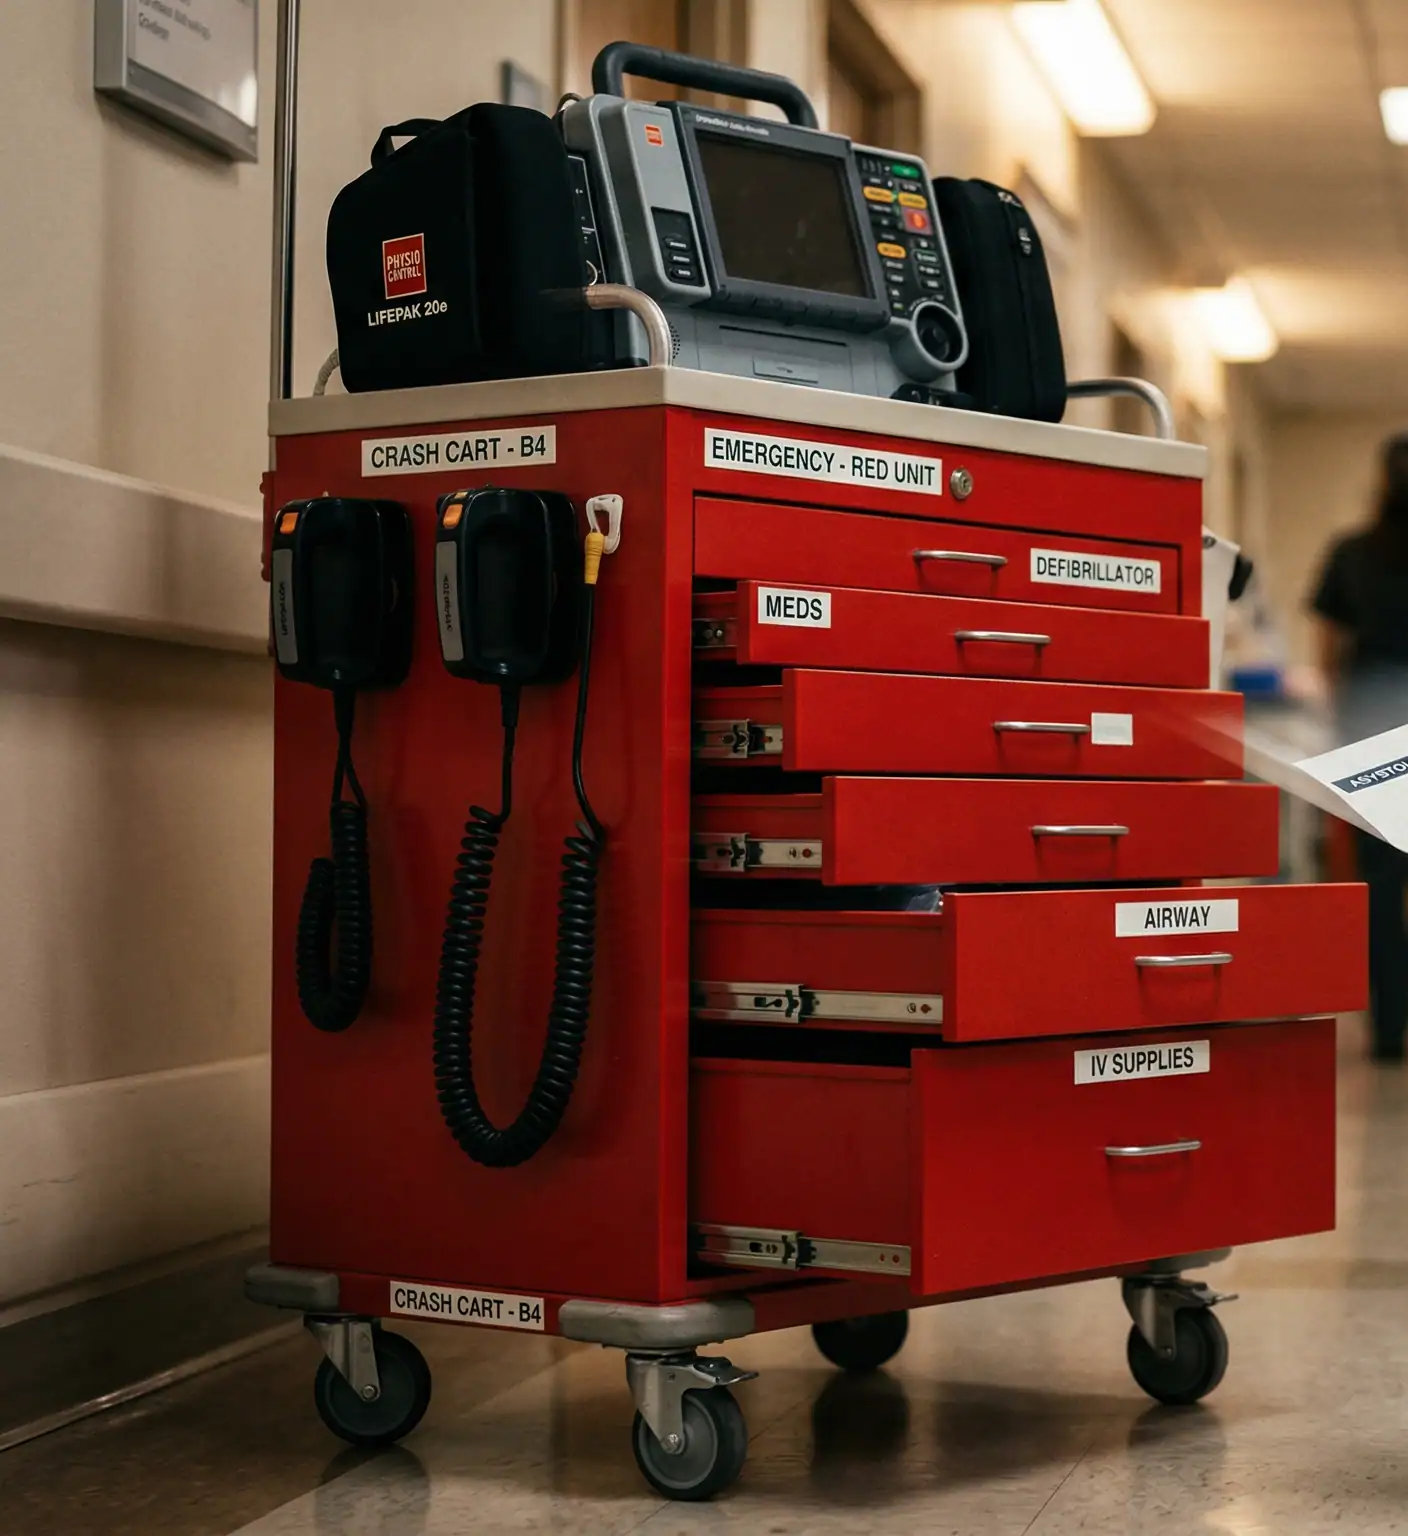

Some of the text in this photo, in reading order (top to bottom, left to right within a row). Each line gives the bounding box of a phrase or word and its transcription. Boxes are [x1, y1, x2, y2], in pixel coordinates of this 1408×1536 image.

[387, 249, 421, 271] PHYSIO
[367, 299, 448, 327] LIFEPAK 20e
[371, 442, 440, 469] CRASH
[445, 437, 501, 463] CART
[520, 434, 546, 458] B4
[712, 436, 835, 473] EMERGENCY
[852, 455, 888, 481] RED
[894, 461, 935, 486] UNIT
[1036, 556, 1155, 587] DEFIBRILLATOR
[766, 594, 823, 620] MEDS
[1144, 905, 1211, 929] AIRWAY
[1091, 1046, 1194, 1076] IV SUPPLIES
[394, 1288, 452, 1314] CRASH
[457, 1295, 504, 1319] CART
[519, 1302, 542, 1324] B4
